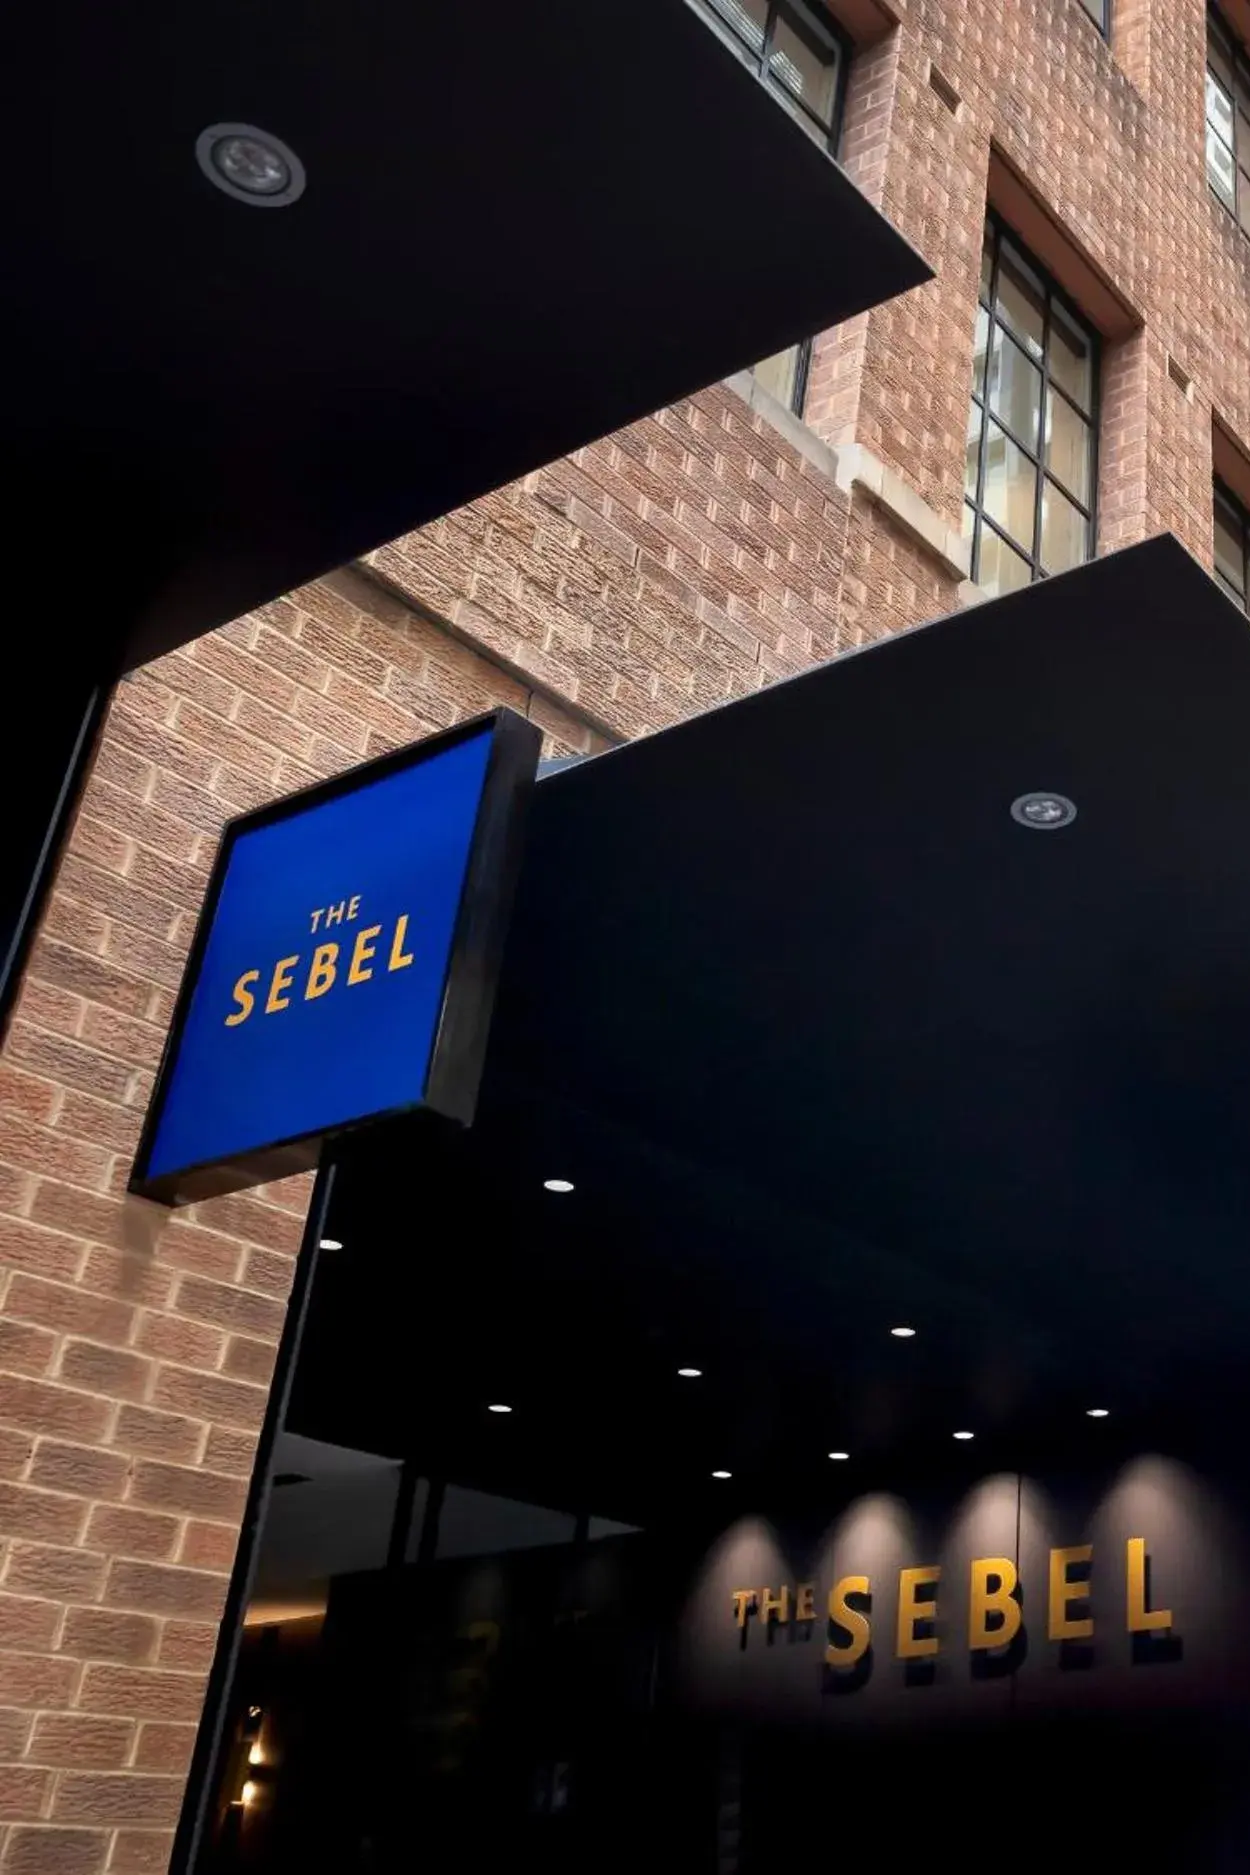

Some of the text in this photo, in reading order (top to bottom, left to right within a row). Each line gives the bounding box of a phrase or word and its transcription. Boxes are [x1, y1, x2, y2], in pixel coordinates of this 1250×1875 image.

[224, 914, 414, 1027] SEBEL
[310, 895, 361, 934] THE
[732, 1537, 1173, 1669] THE SEBEL
